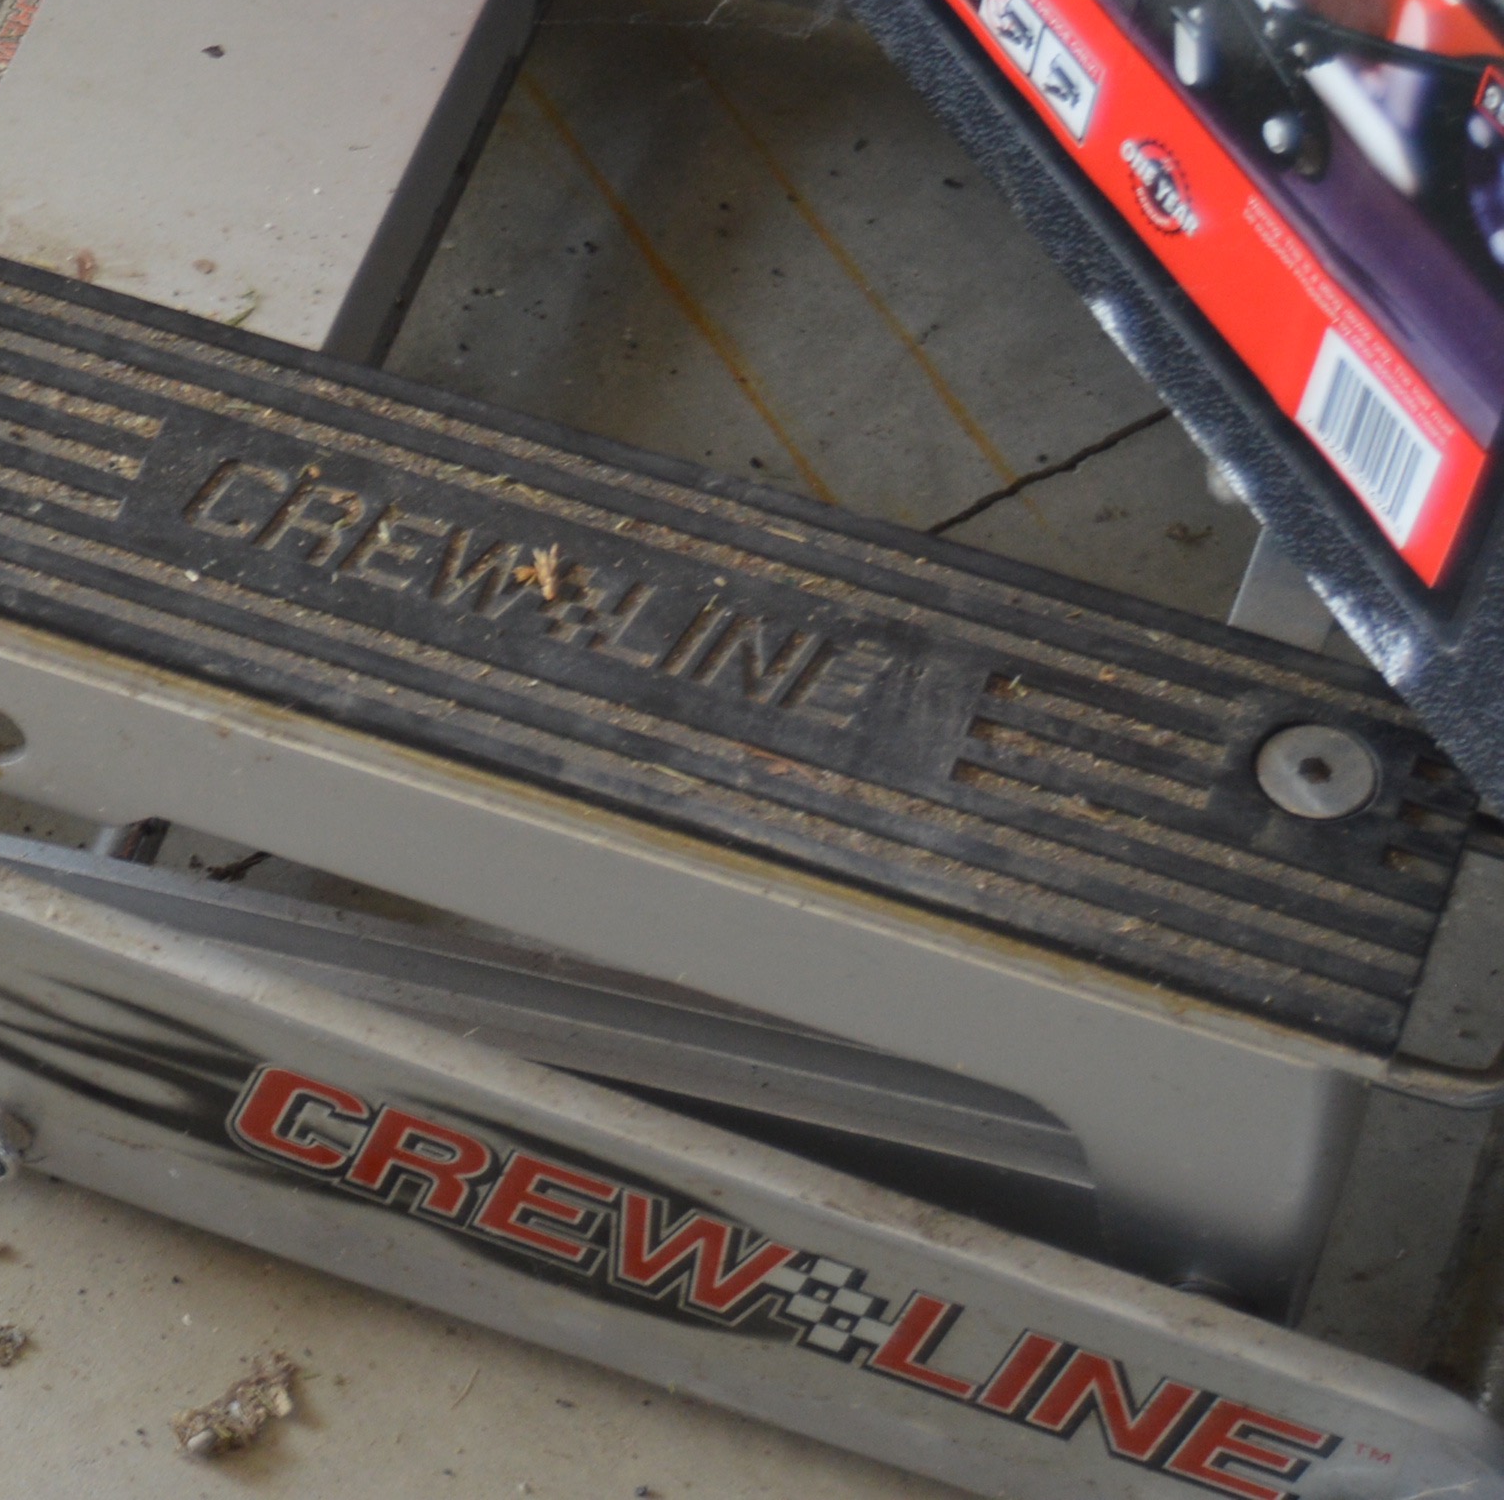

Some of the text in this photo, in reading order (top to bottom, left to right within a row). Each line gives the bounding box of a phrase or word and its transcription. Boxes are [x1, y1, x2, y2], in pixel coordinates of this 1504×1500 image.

[1155, 178, 1200, 239] YEAR
[183, 457, 895, 731] CREW LINE
[226, 1062, 795, 1324] CREW
[869, 1292, 1344, 1500] LINE
